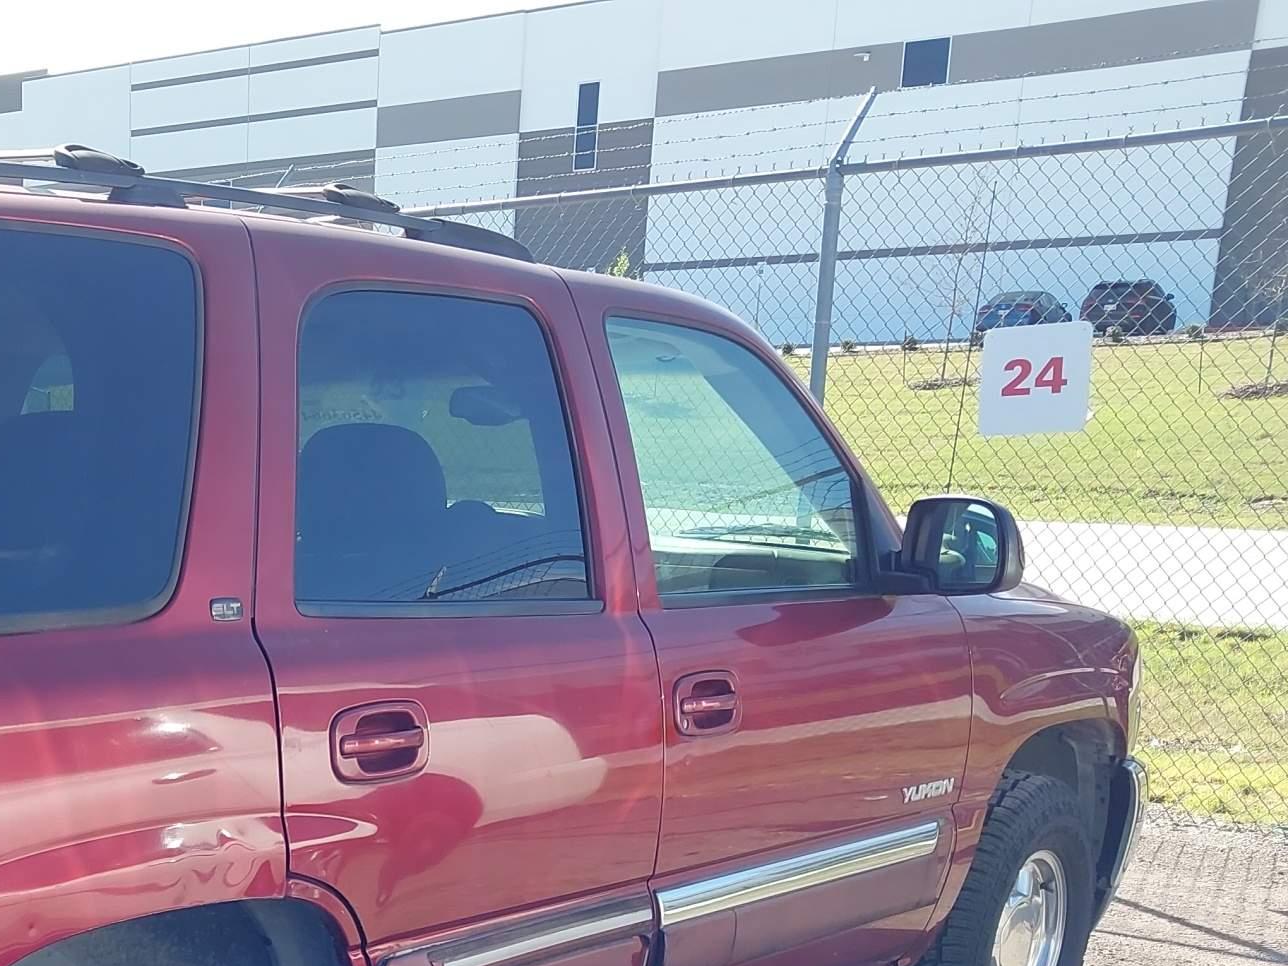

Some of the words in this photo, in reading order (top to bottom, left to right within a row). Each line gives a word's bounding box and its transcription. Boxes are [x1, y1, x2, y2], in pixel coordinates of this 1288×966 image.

[1001, 356, 1068, 397] 24
[212, 602, 241, 616] SLT
[902, 777, 955, 804] YUKON
